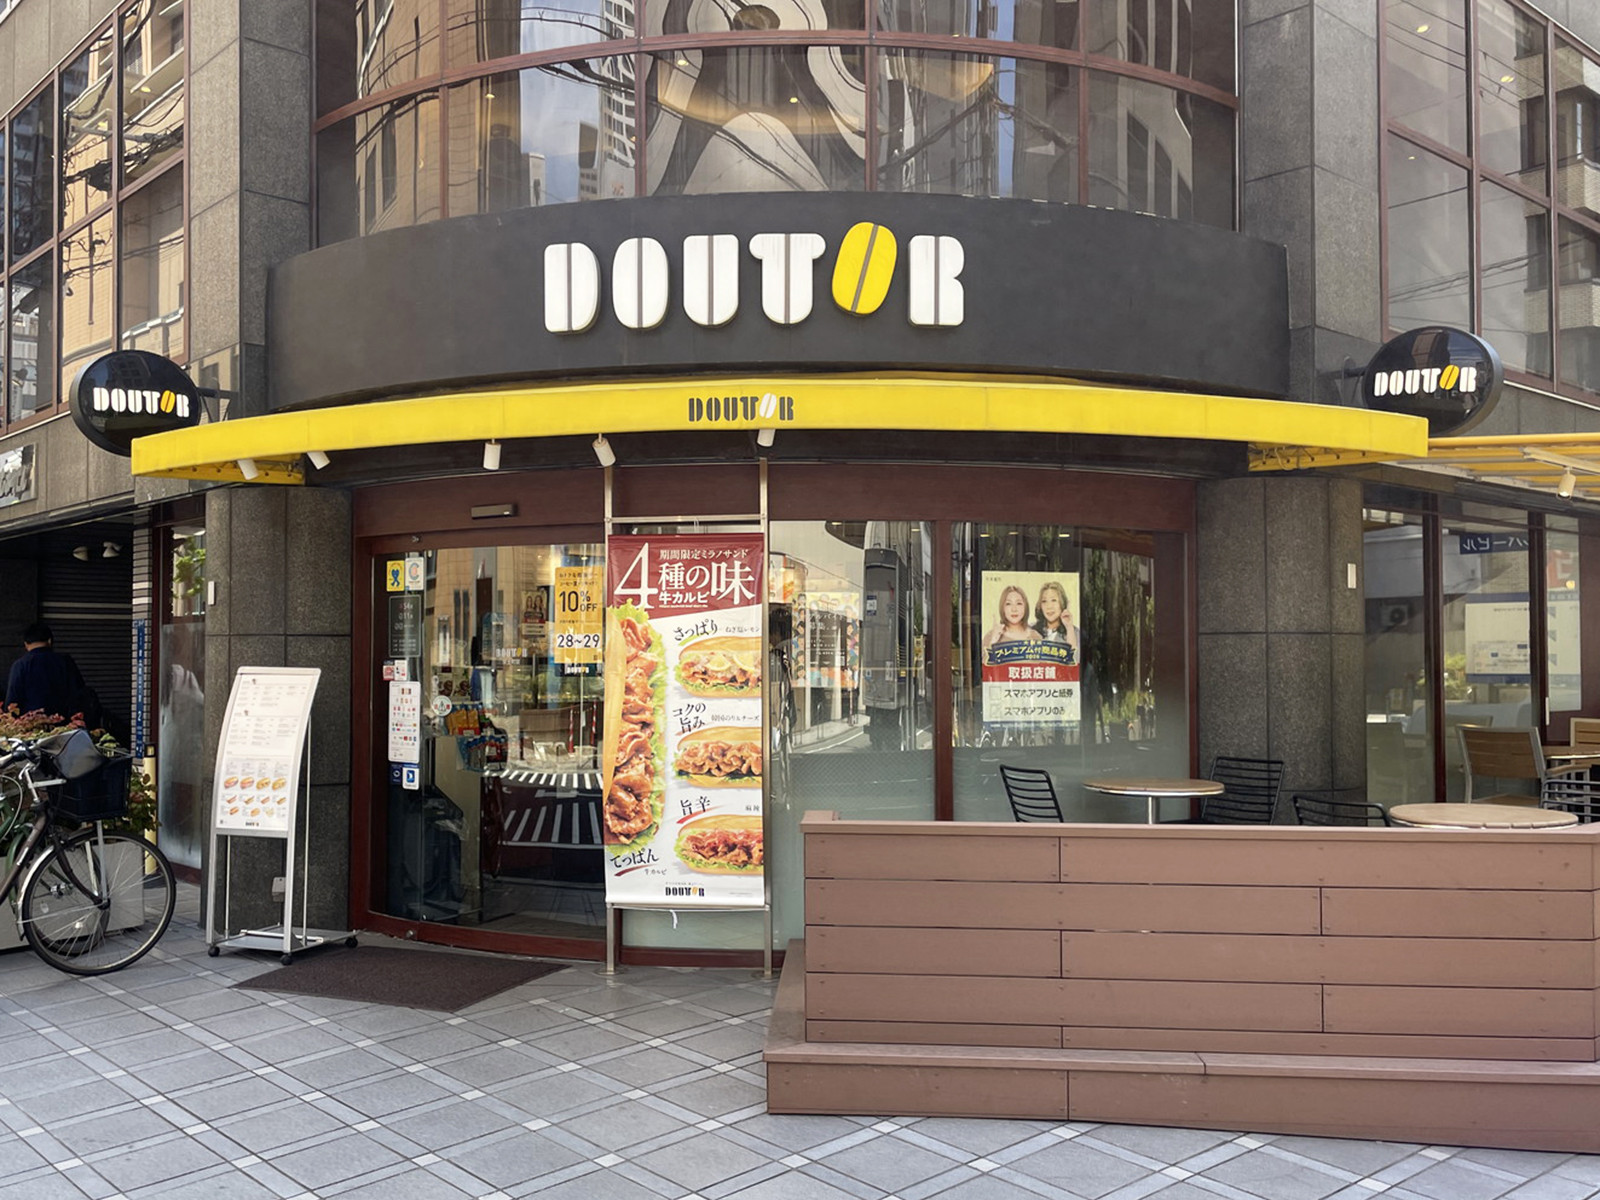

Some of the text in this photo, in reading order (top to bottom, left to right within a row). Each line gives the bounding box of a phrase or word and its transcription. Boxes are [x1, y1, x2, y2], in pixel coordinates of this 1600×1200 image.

[543, 221, 966, 333] DOUTOR
[1374, 364, 1477, 397] DOUTOR
[93, 387, 190, 418] DOUTOR
[688, 392, 794, 422] DOUTOR
[659, 548, 749, 560] 期間限定ミラノサンド
[658, 591, 709, 605] 牛カルビ
[579, 603, 598, 612] OFF
[673, 619, 718, 641] さっぱり
[1008, 666, 1056, 680] 取扱店舗
[672, 702, 707, 718] コクの
[679, 716, 706, 733] 旨み
[680, 796, 711, 816] 旨辛
[610, 848, 660, 868] てっぱん
[665, 886, 705, 897] DOUTOR
